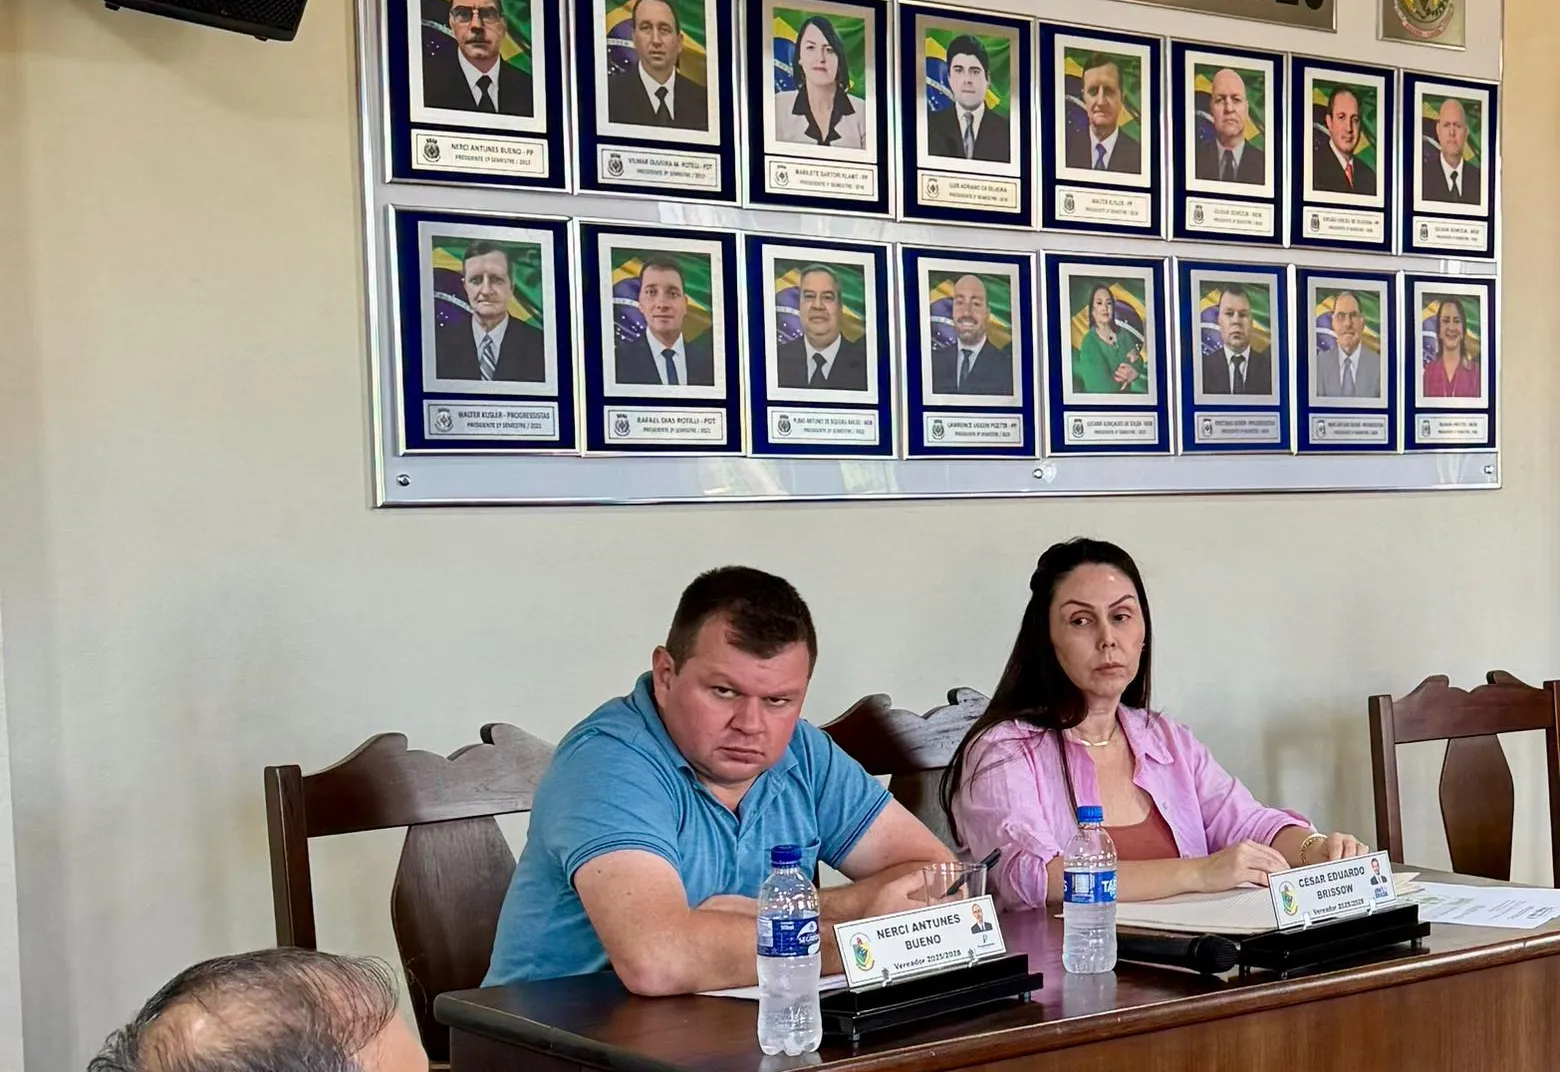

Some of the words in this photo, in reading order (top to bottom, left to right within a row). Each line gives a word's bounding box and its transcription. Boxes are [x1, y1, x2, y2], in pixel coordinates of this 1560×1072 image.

[470, 144, 499, 154] ANTUNES
[1298, 874, 1327, 888] CESAR
[1328, 866, 1365, 882] EDUARDO
[1317, 884, 1354, 900] BRISSOW
[1313, 905, 1337, 916] Vereador
[876, 925, 910, 940] NERCI
[912, 914, 961, 934] ANTUNES
[904, 934, 942, 951] BUENO
[893, 958, 926, 970] Vereador
